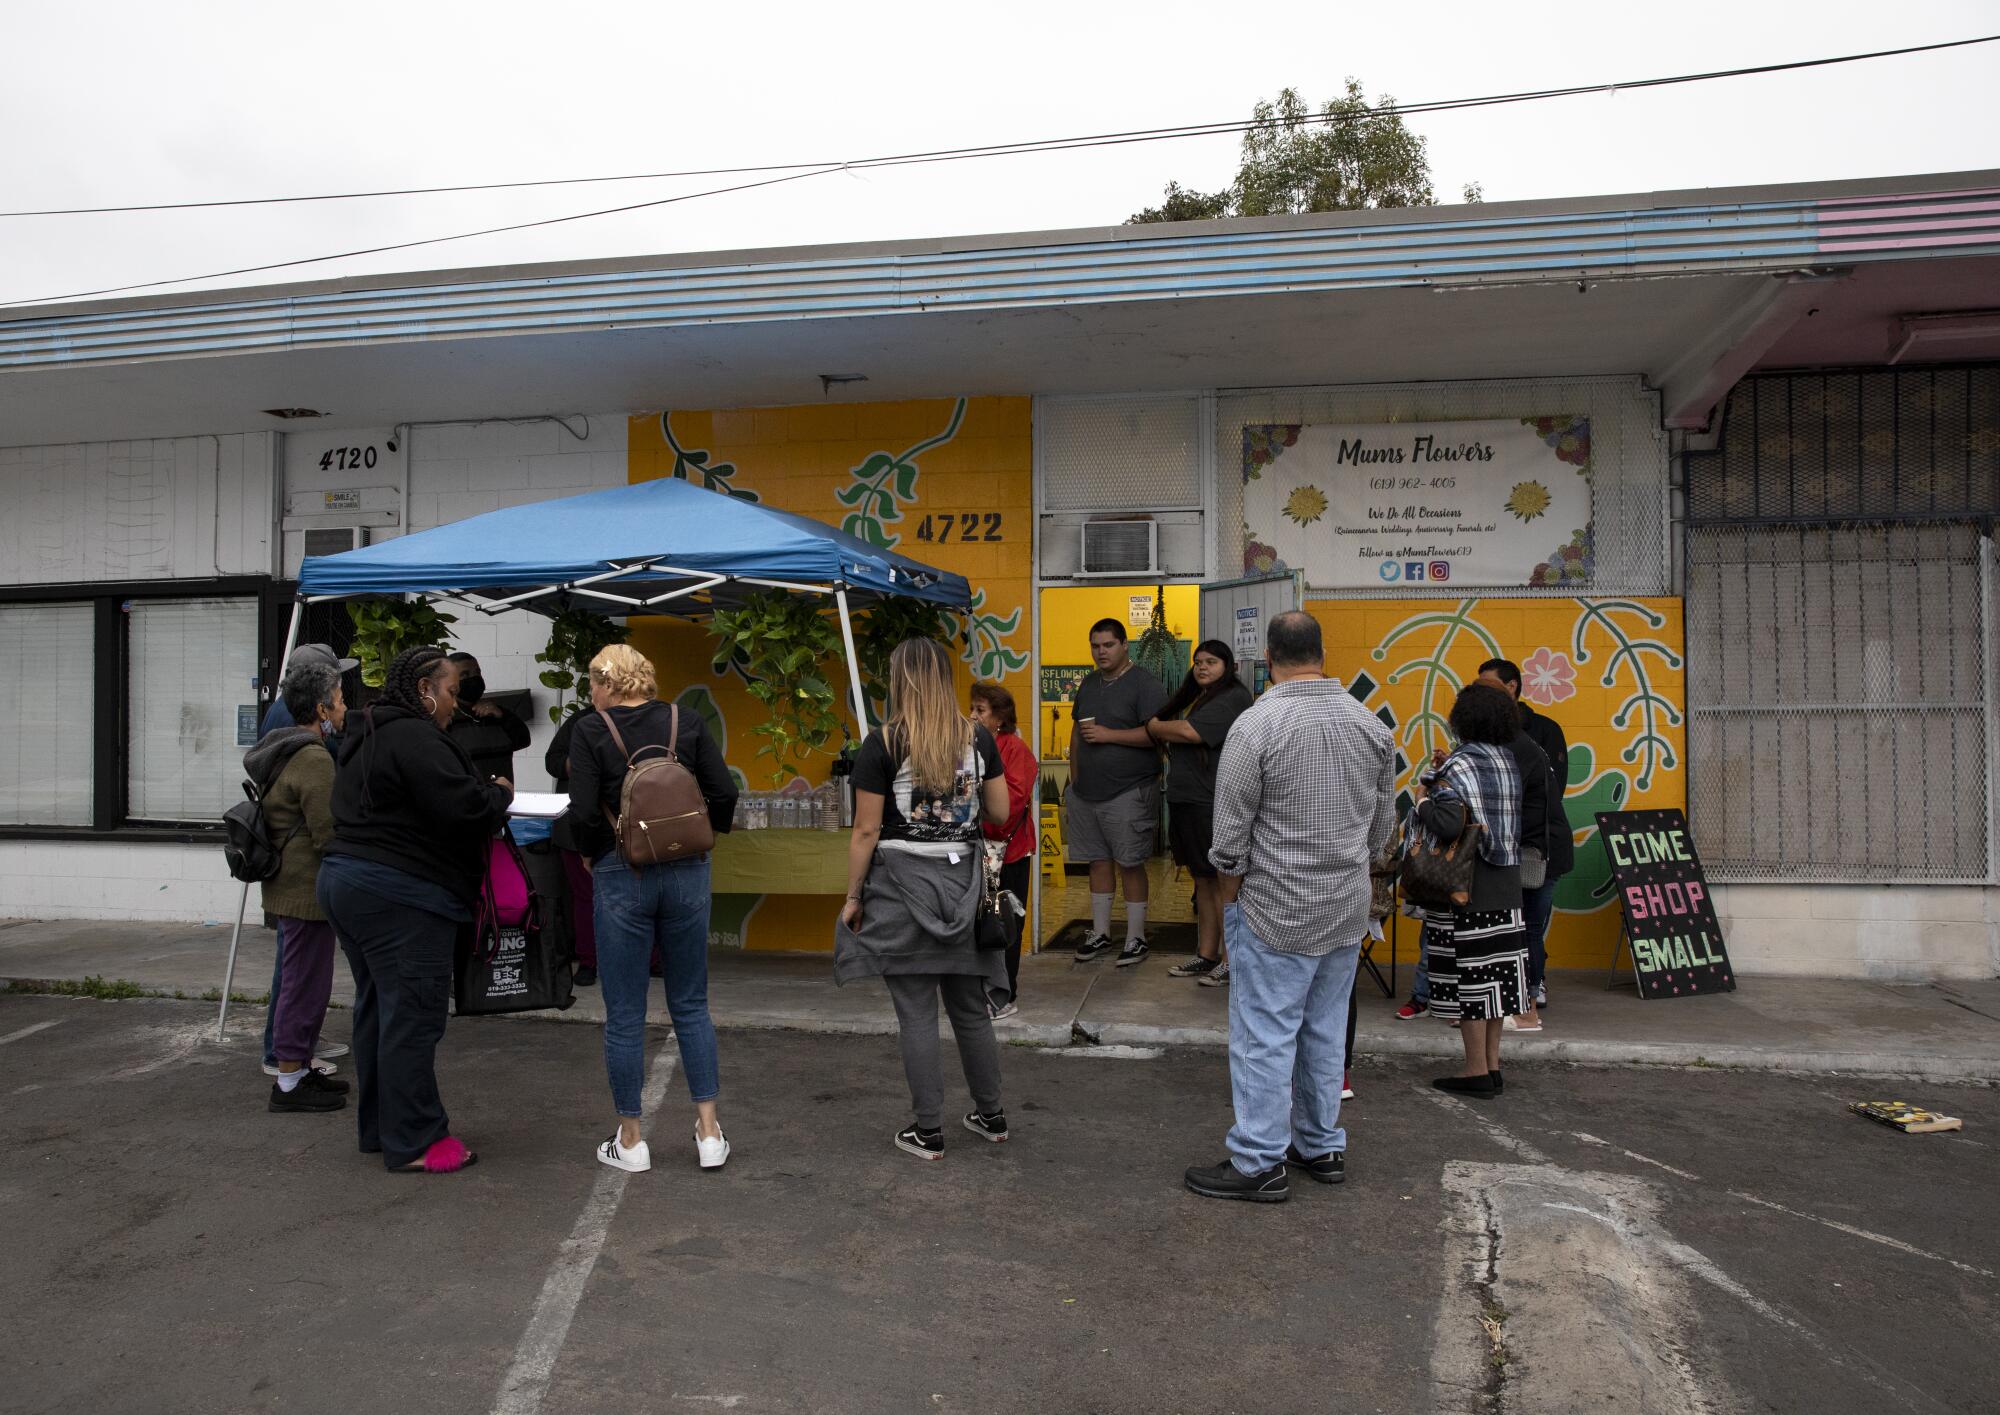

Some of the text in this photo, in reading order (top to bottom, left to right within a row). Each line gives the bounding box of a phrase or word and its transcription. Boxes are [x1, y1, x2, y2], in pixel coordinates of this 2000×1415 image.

[319, 446, 377, 471] 4720
[1337, 434, 1495, 466] Mums Flowers
[1370, 477, 1396, 490] (619)
[1429, 477, 1457, 488] 4005
[334, 493, 350, 501] SMILE
[1368, 506, 1462, 520] We Do All Occasions
[917, 512, 1003, 544] 4722
[1358, 547, 1384, 558] Follow
[1395, 546, 1472, 558] @MumsFlowers619
[1238, 609, 1257, 618] NOTICE
[1608, 830, 1692, 866] COME
[1625, 881, 1705, 919] SHOP
[1633, 931, 1724, 973] SMALL
[493, 968, 522, 980] BEST
